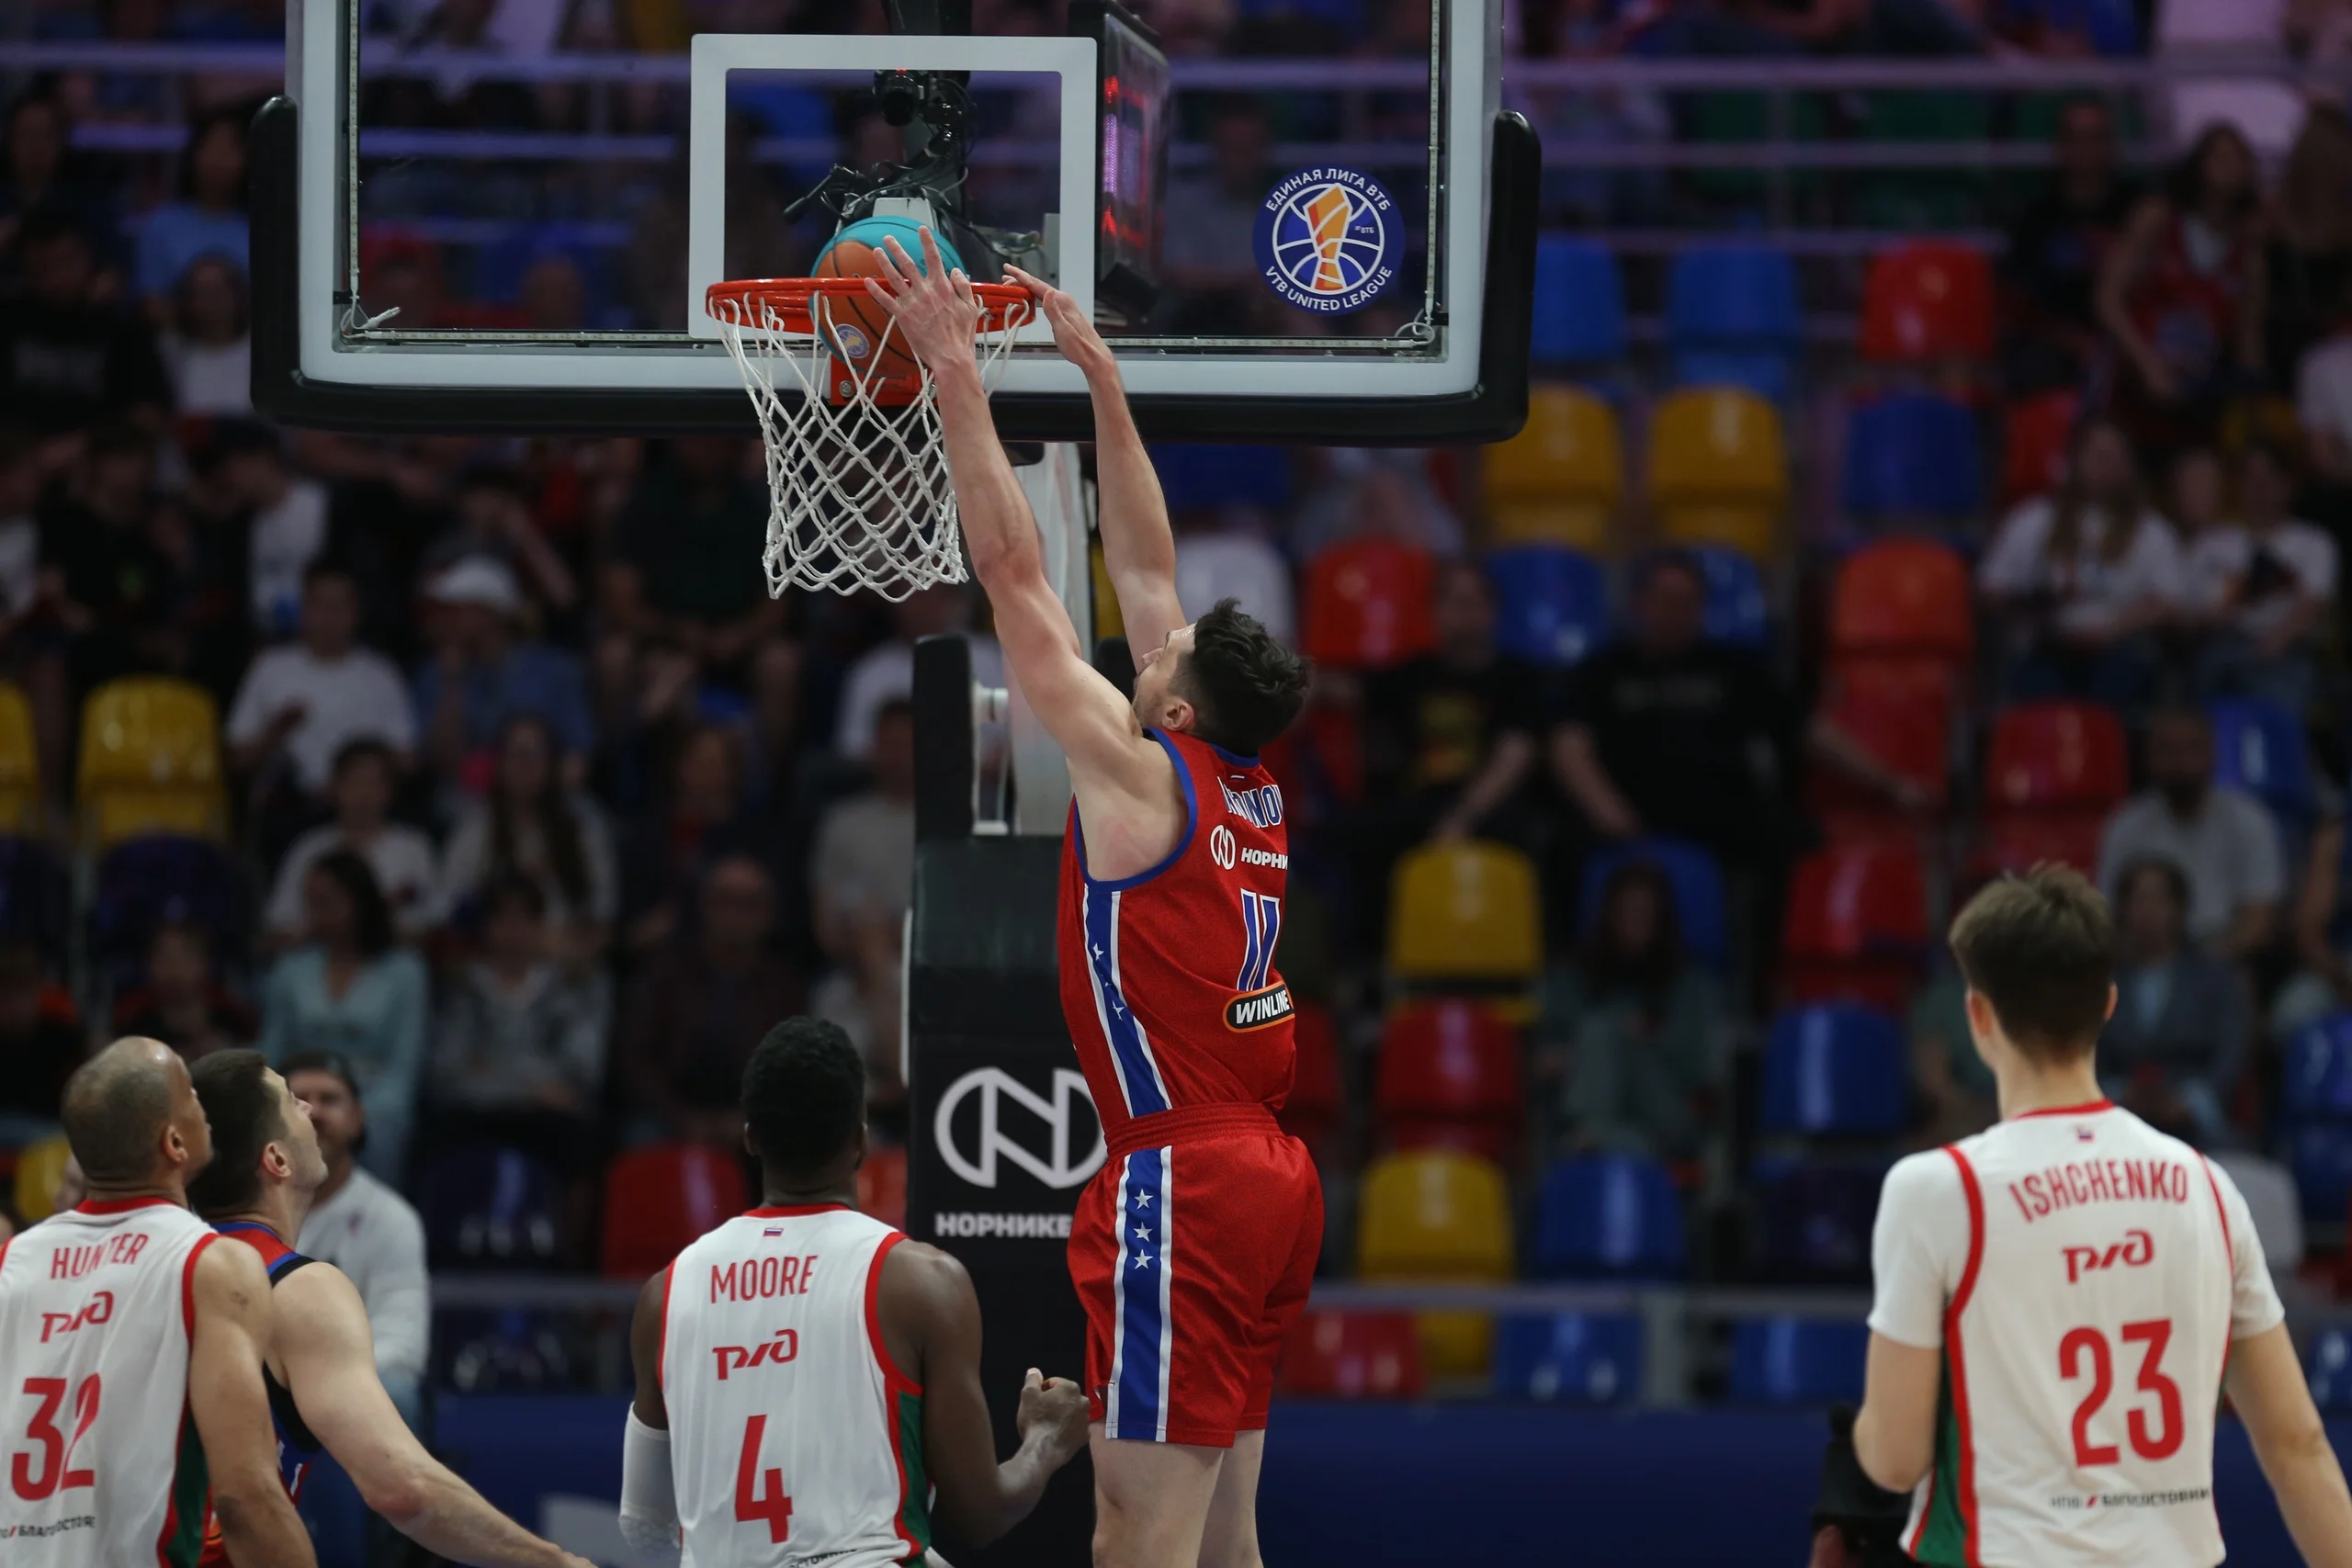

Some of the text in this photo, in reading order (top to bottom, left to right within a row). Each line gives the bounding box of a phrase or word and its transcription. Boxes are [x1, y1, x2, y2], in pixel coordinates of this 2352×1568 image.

[1265, 168, 1391, 212] ЕДИНАЯ ЛИГА ВТБ
[1265, 265, 1393, 310] VTB UNITED LEAGUE
[1237, 887, 1281, 992] 11
[1236, 989, 1290, 1024] WINLINE
[2008, 1159, 2188, 1223] ISHCHENKO
[51, 1233, 149, 1280] HUNTER
[710, 1255, 819, 1304] MOORE
[2058, 1319, 2185, 1467] 23
[11, 1372, 101, 1501] 32
[735, 1414, 794, 1544] 4
